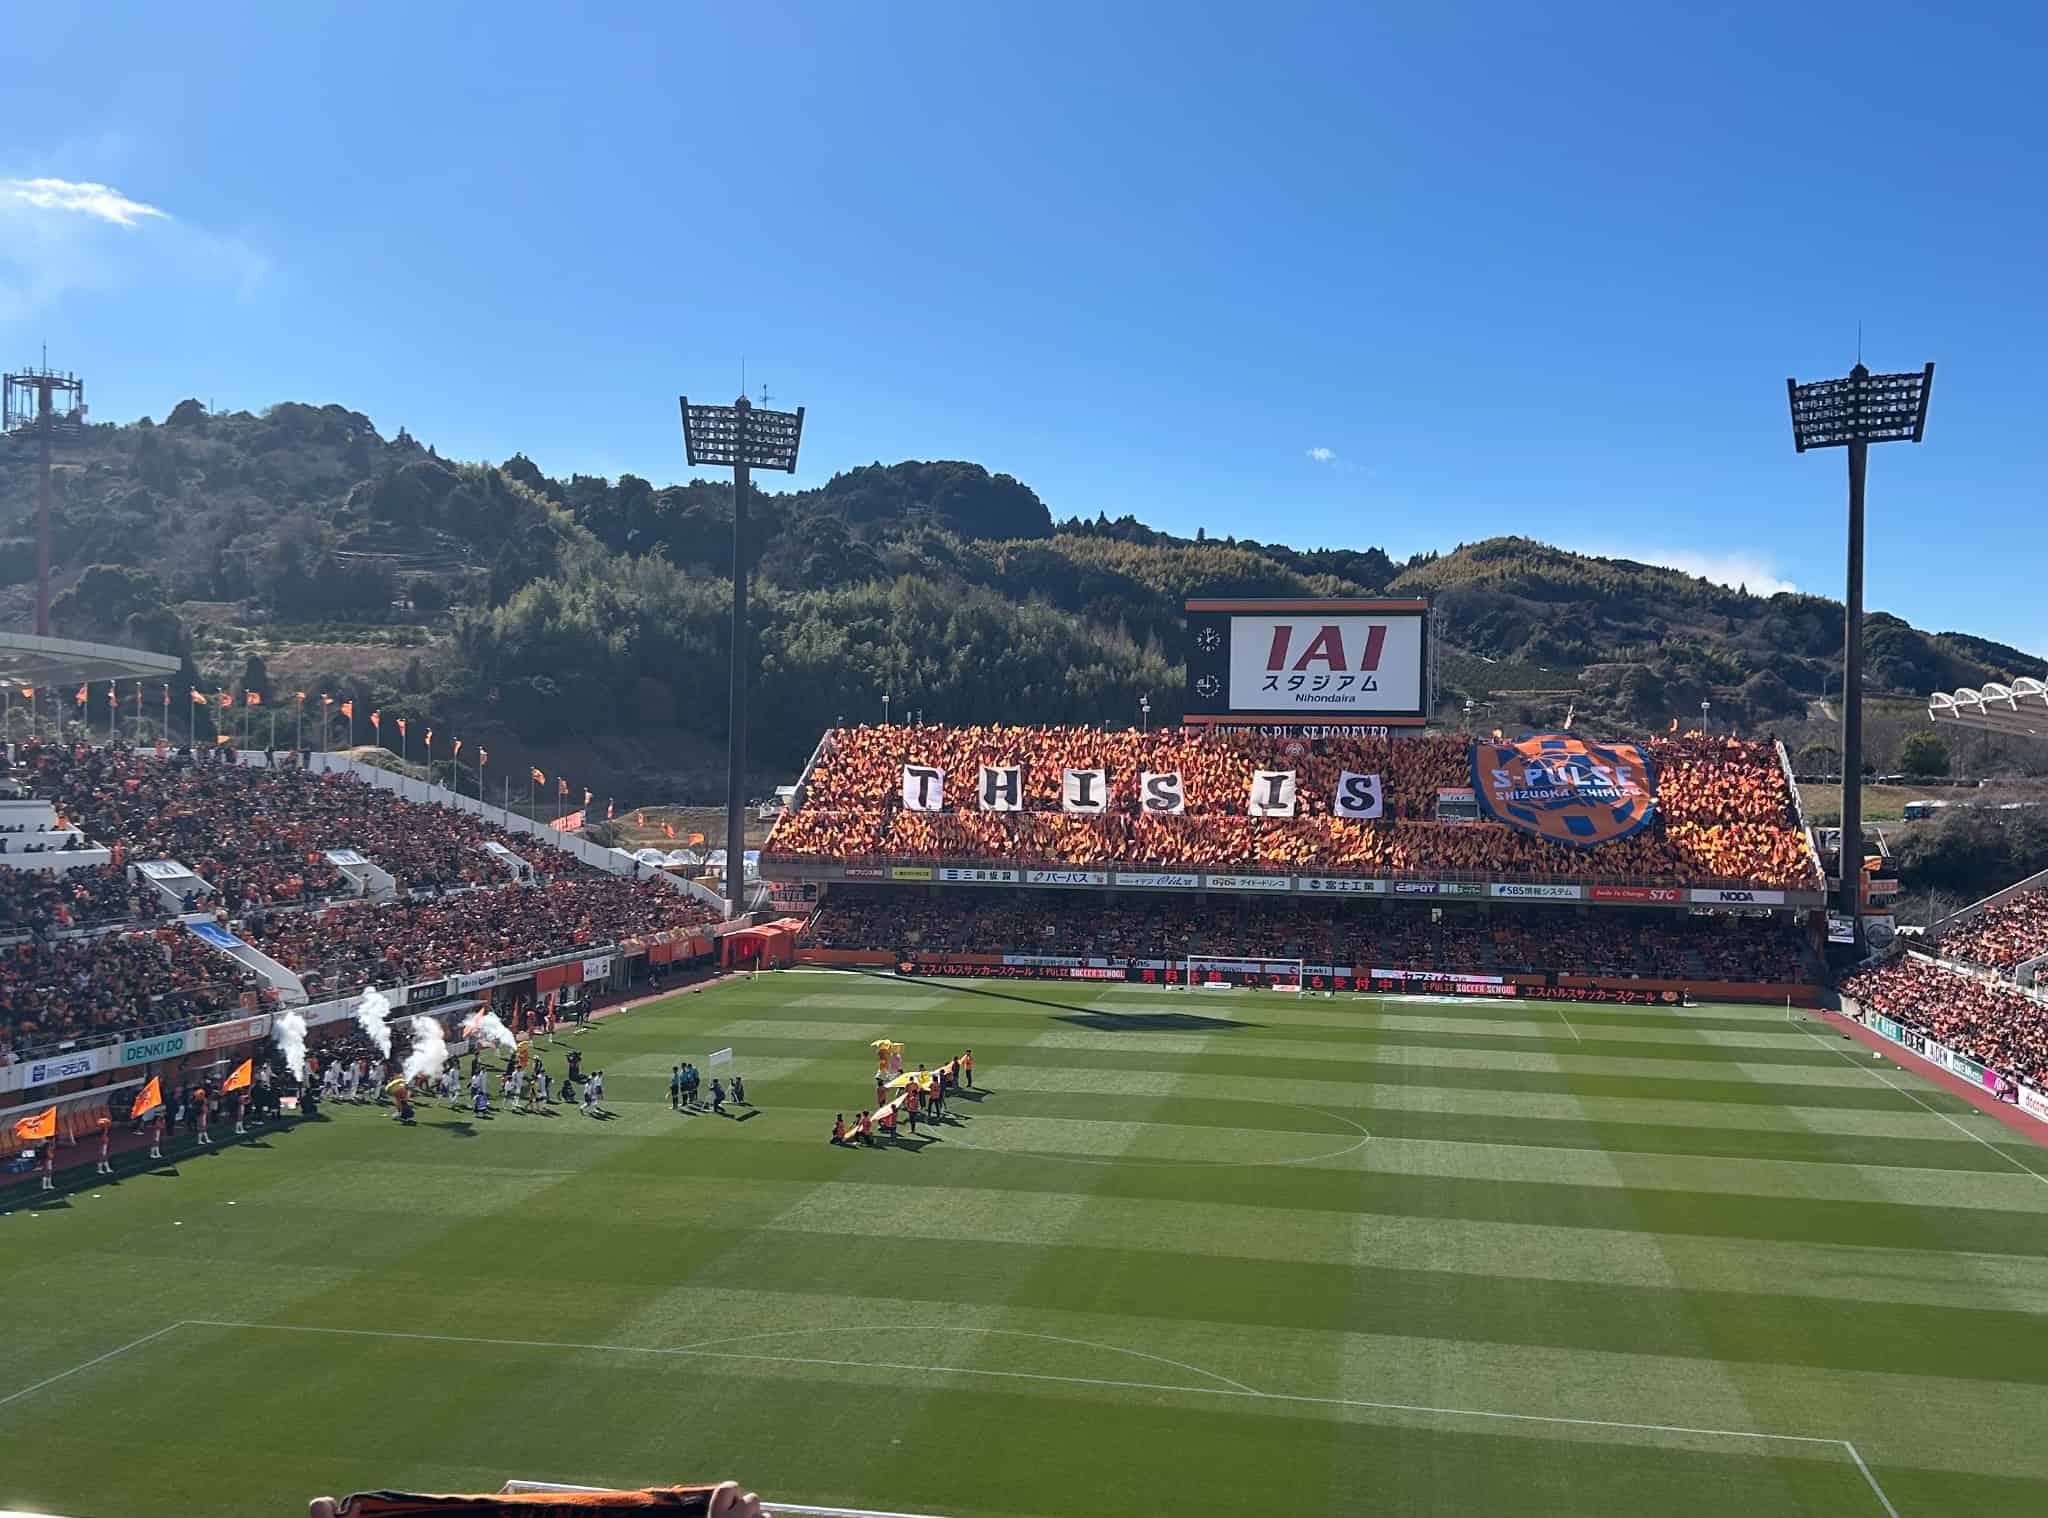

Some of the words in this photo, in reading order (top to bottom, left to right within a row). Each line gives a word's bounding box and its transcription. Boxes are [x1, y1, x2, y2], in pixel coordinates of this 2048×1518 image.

[1266, 625, 1388, 672] IAI
[1262, 674, 1379, 692] スタジアム
[1295, 692, 1356, 703] Nihondaira
[1491, 766, 1637, 789] S-PULSE
[1495, 788, 1571, 801] SHIZUOKA
[1649, 889, 1675, 900] STC
